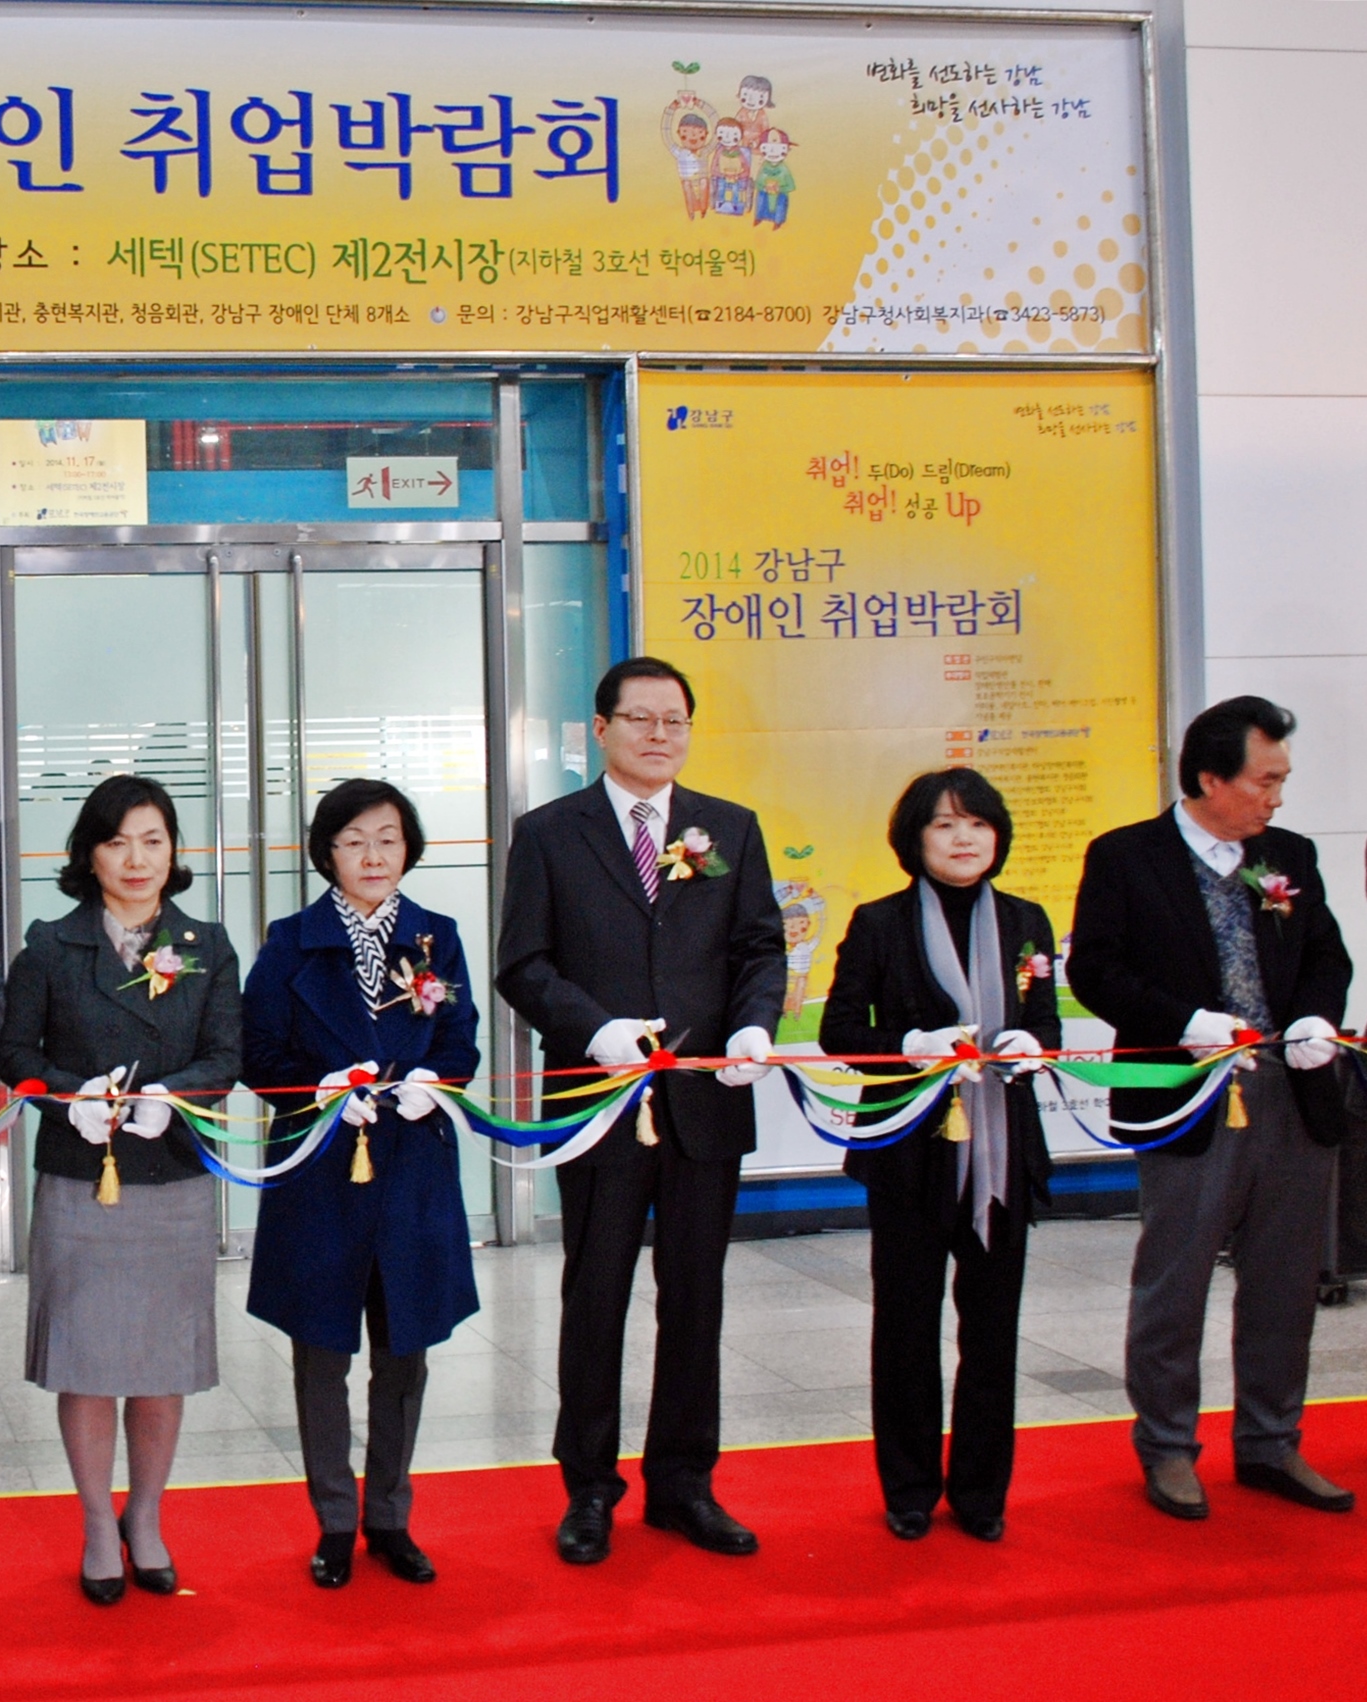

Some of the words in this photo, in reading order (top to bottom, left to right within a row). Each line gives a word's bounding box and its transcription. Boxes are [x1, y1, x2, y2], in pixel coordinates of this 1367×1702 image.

[928, 61, 996, 84] 선도하는
[1005, 62, 1043, 87] 강남
[910, 94, 962, 123] 희망을
[967, 96, 1044, 121] 선사하는
[1051, 98, 1092, 121] 강남
[120, 87, 620, 204] 취업박람회
[106, 238, 317, 279] 세텍(SETEC)
[593, 250, 650, 276] 3호선
[659, 247, 756, 278] 학여울역)
[33, 304, 127, 324] 충현복지관,
[131, 304, 205, 325] 청음회관,
[210, 304, 262, 325] 강남구
[268, 304, 319, 325] 장애인
[325, 304, 360, 324] 단체
[366, 304, 410, 324] 8개소
[456, 304, 495, 325] 문의
[690, 409, 734, 423] 강남구
[83, 456, 96, 466] 17
[806, 450, 860, 488] 취업!
[867, 461, 914, 481] 두(Do)
[921, 457, 1011, 483] 드림(Dream)
[391, 478, 426, 489] EXIT
[843, 483, 898, 523] 취업!
[904, 497, 938, 520] 성공
[946, 492, 982, 527] Up
[679, 550, 742, 580] 2014
[753, 547, 846, 583] 강남구
[681, 592, 806, 641] 장애인
[819, 589, 1022, 639] 취업박람회
